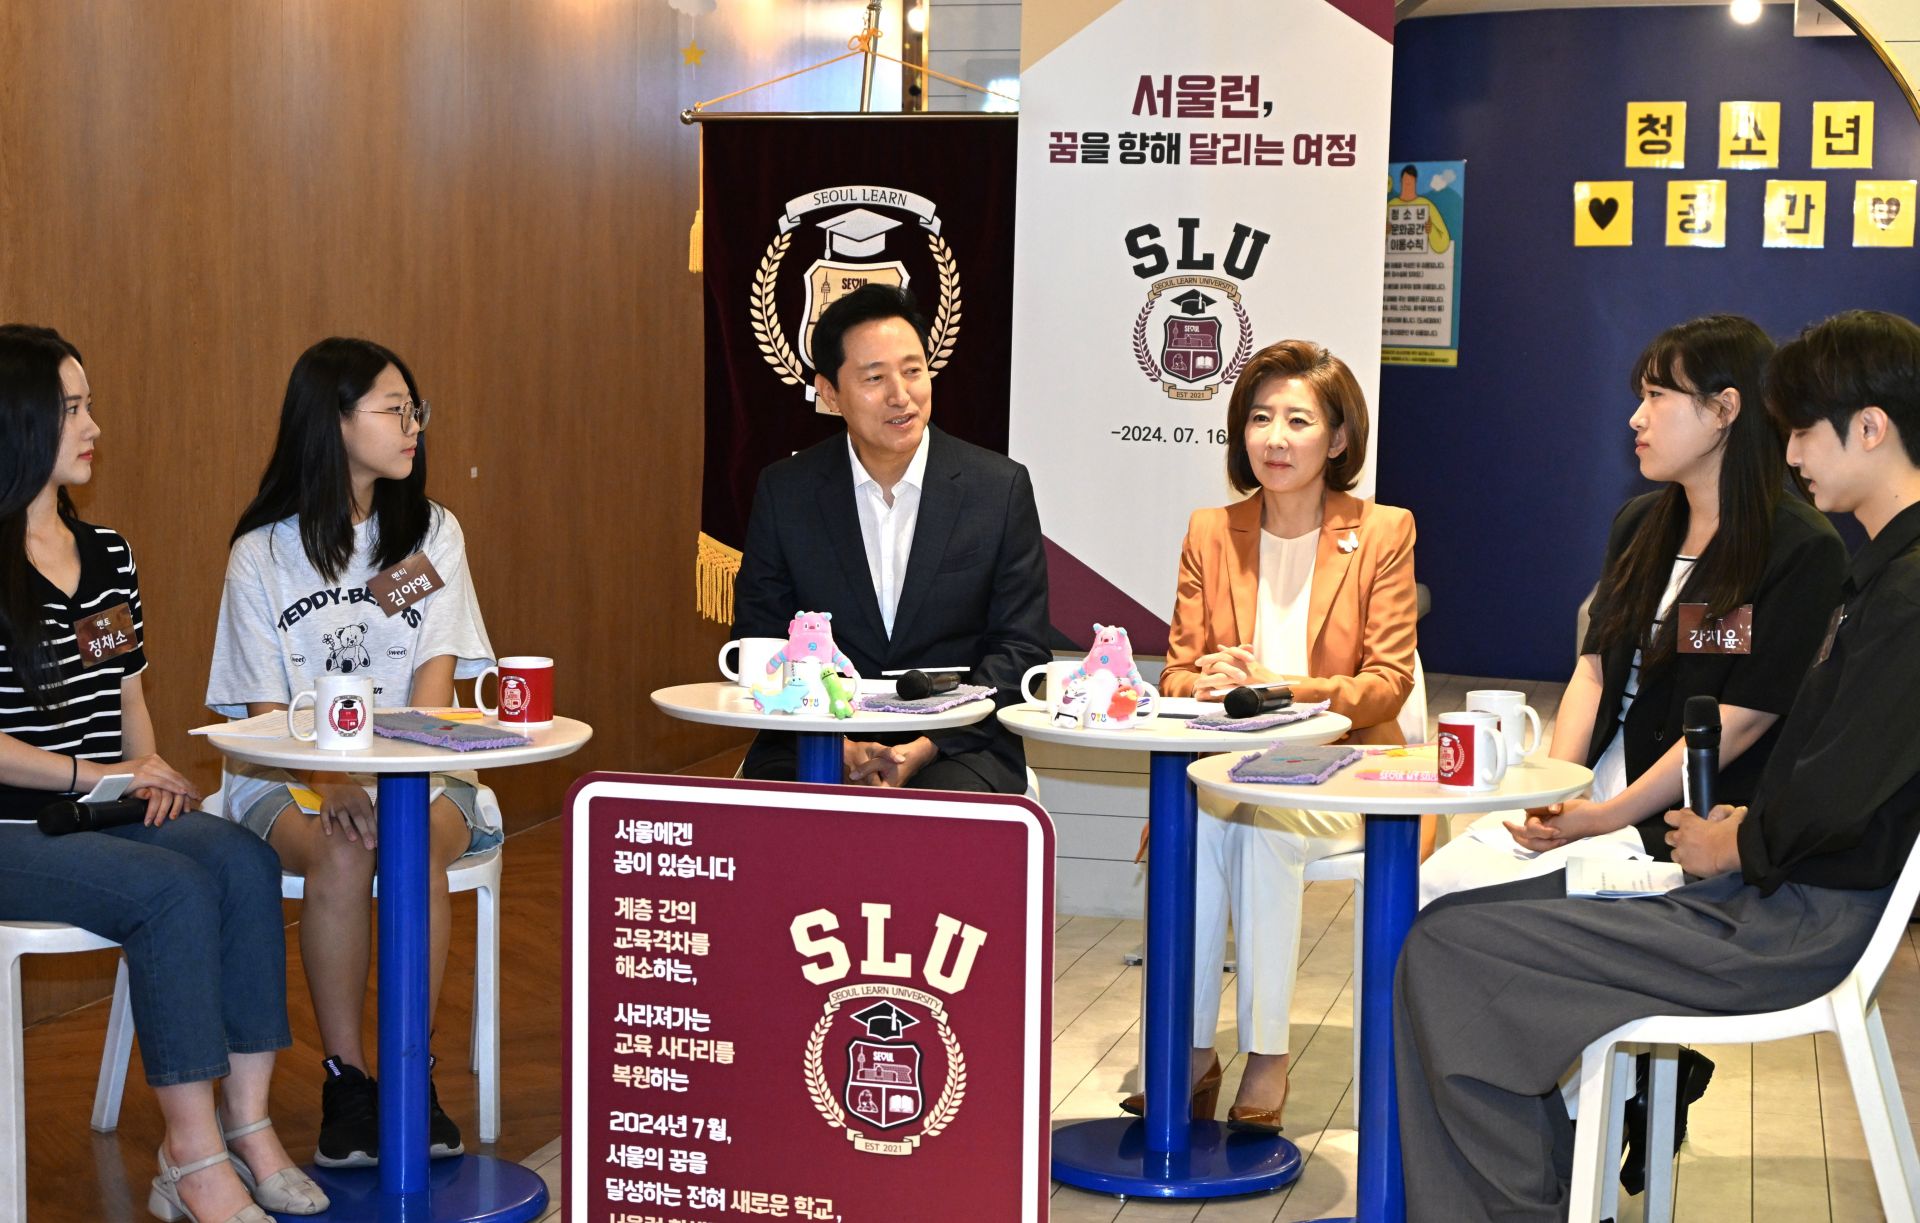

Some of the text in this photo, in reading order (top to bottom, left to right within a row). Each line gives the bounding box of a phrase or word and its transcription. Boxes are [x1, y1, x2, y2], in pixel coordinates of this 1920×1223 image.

[1132, 75, 1273, 118] 서울런,
[1049, 132, 1357, 167] 꿈을 향해 달리는 여정
[813, 188, 908, 207] SEOUL LEARN
[1125, 218, 1271, 281] SLU
[1154, 280, 1176, 290] SEOUL
[1200, 278, 1236, 292] UNIVERSITY
[1174, 427, 1199, 444] 07.
[387, 573, 433, 607] 김야엘
[88, 630, 128, 658] 정채소
[614, 819, 693, 847] 서울에겐
[613, 850, 736, 882] 꿈이 있습니다
[614, 896, 697, 925] 계층 간의
[614, 928, 710, 957] 교육격차를
[789, 902, 988, 994] SLU
[614, 956, 698, 986] 해소하는,
[831, 985, 942, 1009] SEOUL LEARN UNIVERSITY
[614, 1002, 711, 1033] 사라져가는
[613, 1033, 736, 1065] 교육 사다리를
[612, 1064, 690, 1093] 복원하는
[609, 1111, 733, 1144] 2024년 7월,
[605, 1144, 709, 1175] 서울의 꿈을
[865, 1142, 902, 1153] EST 2021
[605, 1177, 842, 1223] 달성하는 전혀 새로운 학교,
